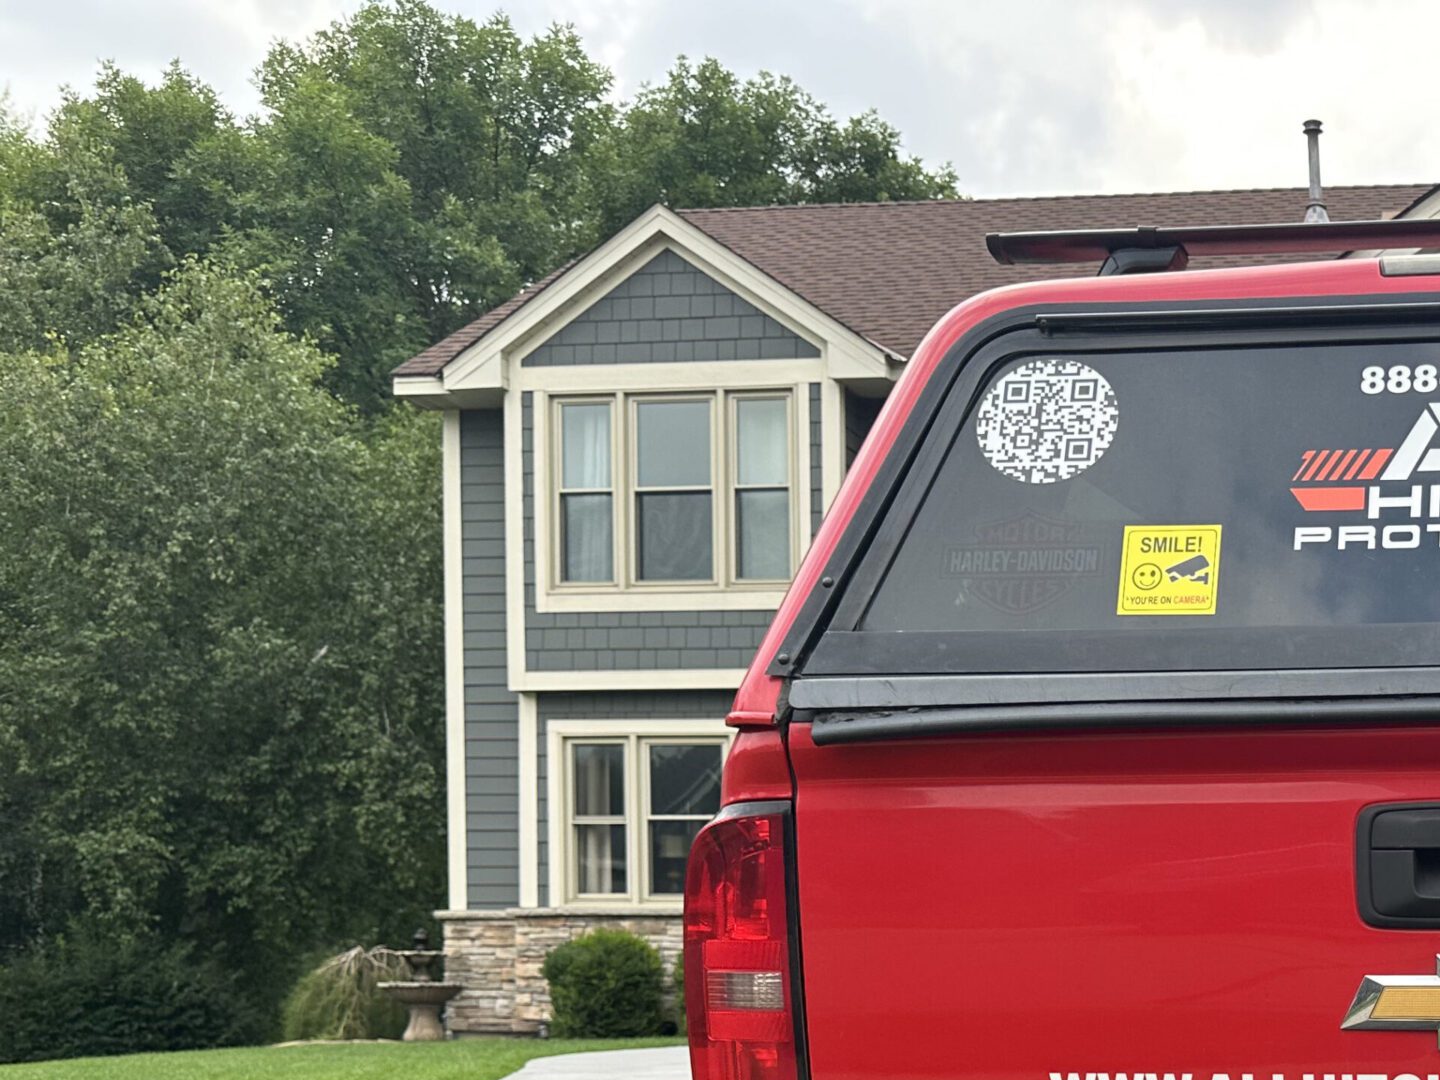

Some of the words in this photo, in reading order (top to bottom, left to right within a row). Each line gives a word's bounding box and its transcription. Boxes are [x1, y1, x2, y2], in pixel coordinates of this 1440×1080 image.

[1140, 536, 1203, 553] SMILE!
[950, 549, 1099, 573] HARLEY-DAVIDSON
[1160, 595, 1172, 604] ON
